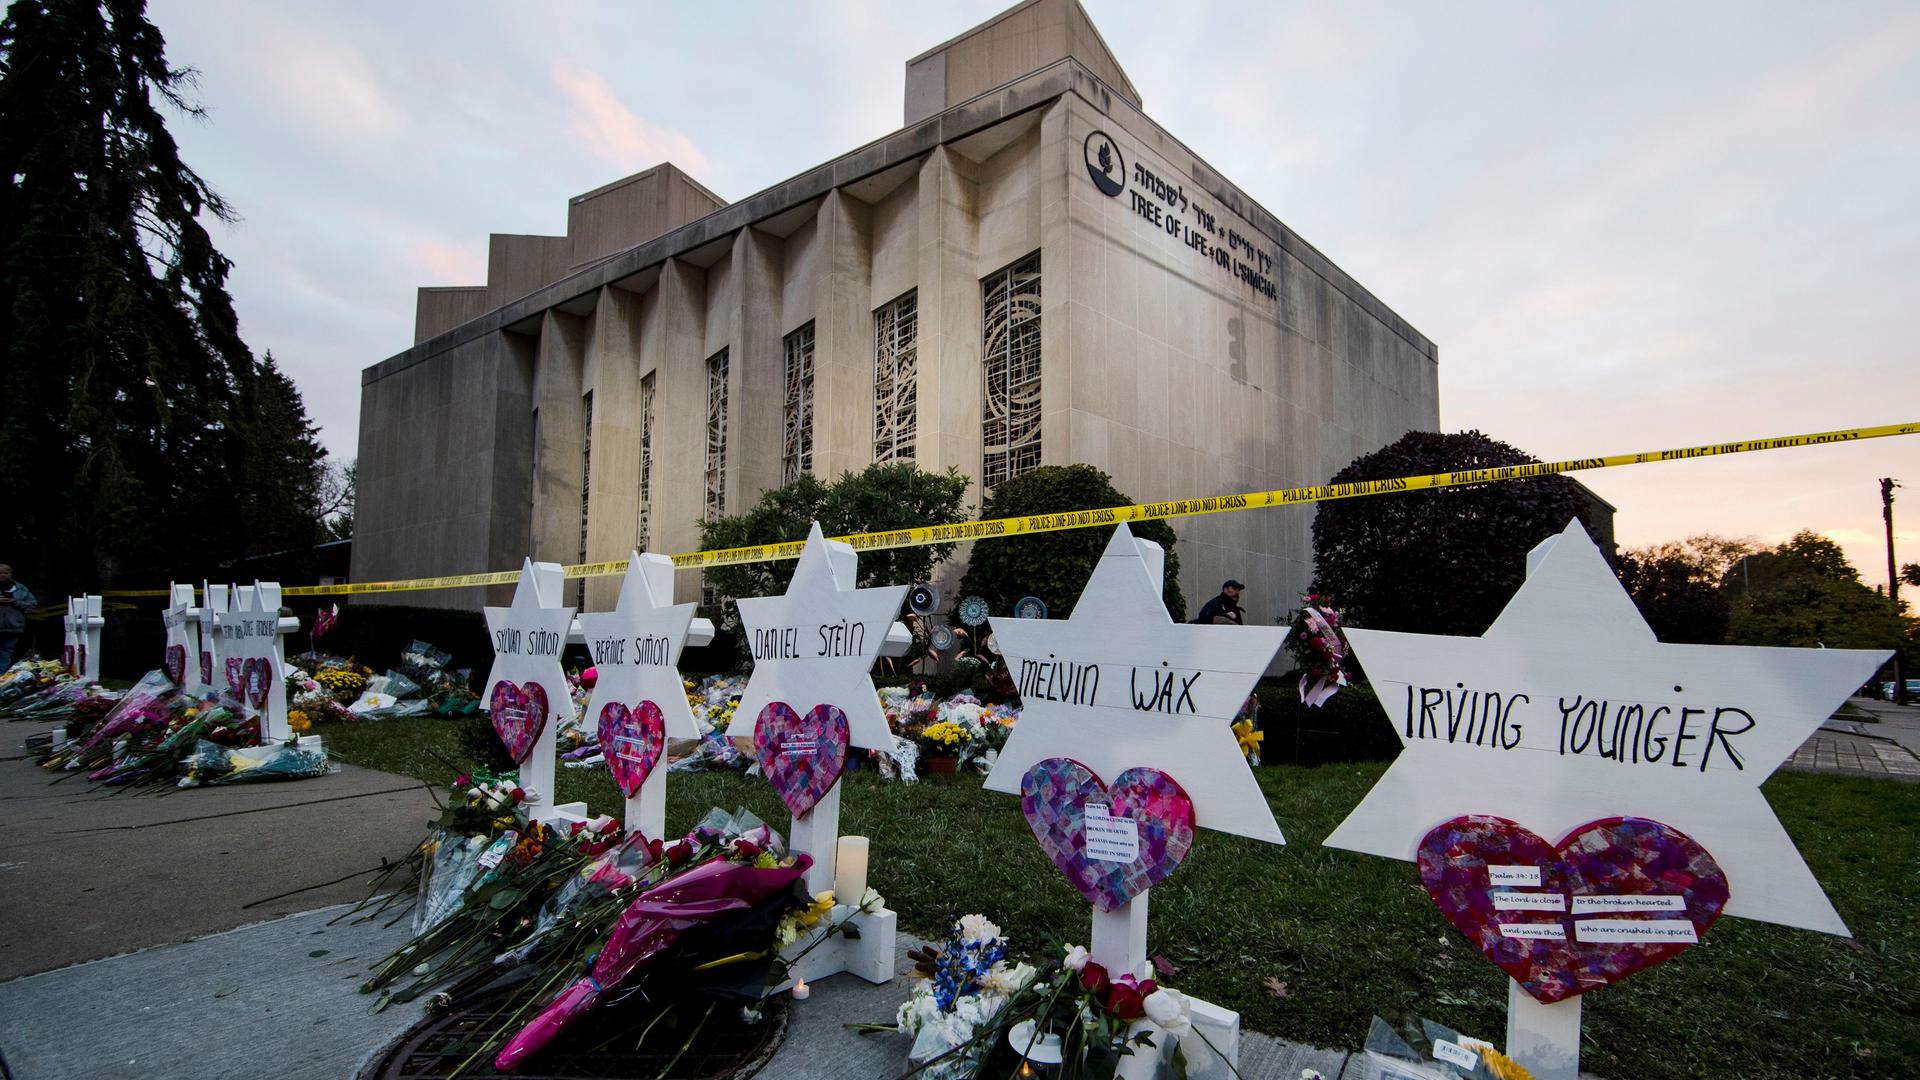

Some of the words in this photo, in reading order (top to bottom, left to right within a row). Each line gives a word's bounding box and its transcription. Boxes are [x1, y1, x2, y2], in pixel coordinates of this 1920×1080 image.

[1134, 162, 1188, 214] לשמחה
[1129, 189, 1162, 229] TREE
[1165, 214, 1181, 238] OF
[1184, 225, 1207, 256] LIFE
[1215, 247, 1230, 272] OR
[1233, 258, 1277, 301] L'SIMCHA
[1450, 469, 1487, 484] POLICE
[1491, 466, 1516, 480] LINE
[1519, 464, 1534, 477] DO
[1539, 461, 1560, 475] NOT
[1282, 489, 1313, 503] POLICE
[1315, 486, 1335, 499] LINE
[1338, 483, 1350, 496] DO
[1353, 480, 1371, 494] NOT
[1374, 477, 1407, 492] CROSS
[1028, 516, 1051, 530] POLICE
[1052, 514, 1065, 528] LINE
[1067, 513, 1075, 526] DO
[1077, 511, 1090, 525] NOT
[1092, 509, 1115, 524] CROSS
[1144, 503, 1169, 518] POLICE
[1171, 501, 1188, 515] LINE
[1189, 499, 1200, 512] DO
[1202, 498, 1217, 511] NOT
[1219, 495, 1247, 509] CROSS
[931, 527, 950, 541] POLICE
[951, 526, 962, 539] LINE
[964, 525, 973, 537] DO
[973, 523, 984, 536] NOT
[985, 521, 1005, 535] CROSS
[496, 629, 521, 655] SYLVAN
[527, 631, 559, 656] SIMON
[596, 639, 626, 665] BERNICE
[634, 637, 669, 666] SIMON
[755, 628, 799, 660] DANIEL
[818, 621, 864, 657] STEIN
[1018, 659, 1099, 706] MELVIN
[1131, 667, 1201, 714] WAX
[1406, 685, 1529, 750] IRVING
[1559, 695, 1756, 773] YOUNGER
[1511, 896, 1531, 904] Lord
[1540, 897, 1561, 905] close
[1603, 898, 1635, 906] broken
[1543, 929, 1565, 937] those
